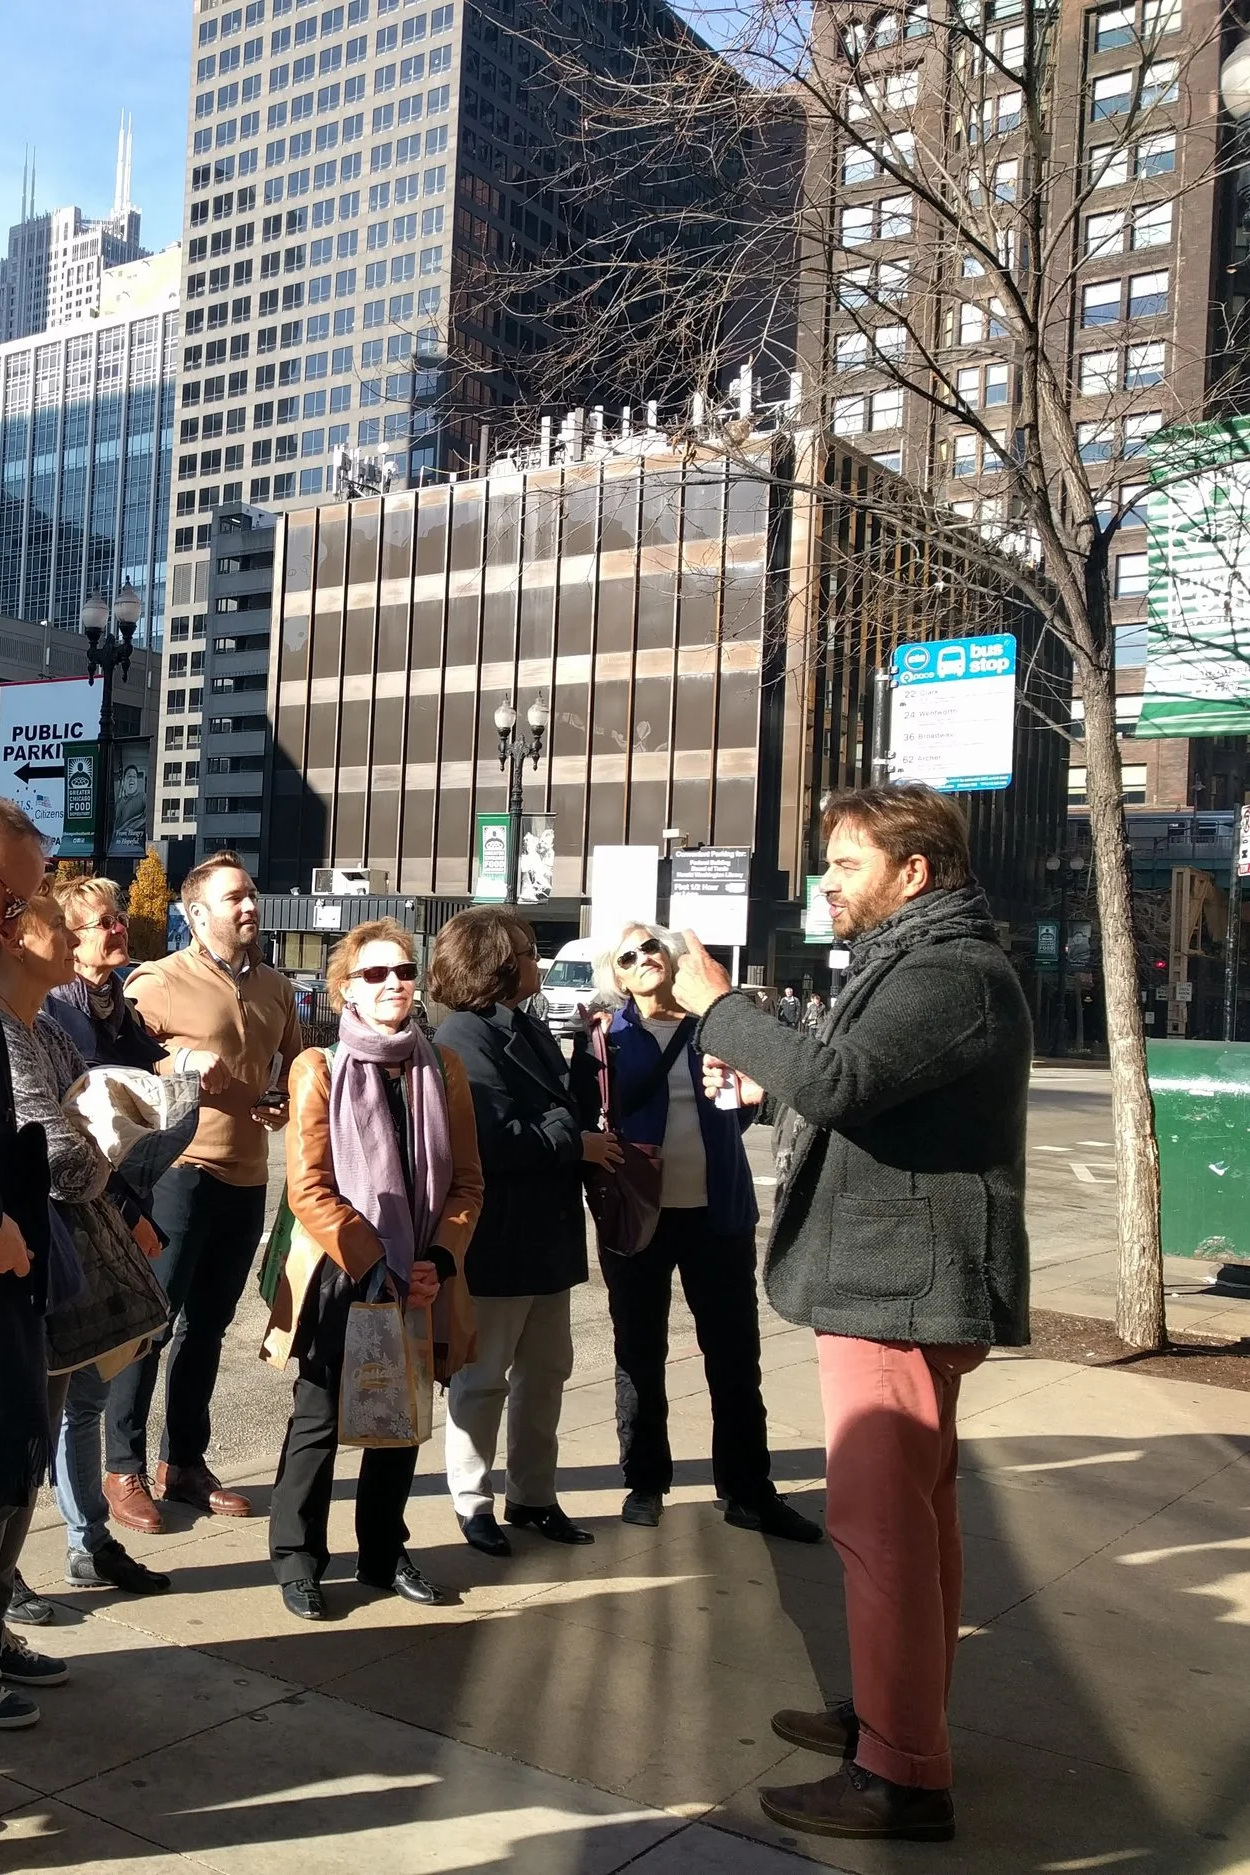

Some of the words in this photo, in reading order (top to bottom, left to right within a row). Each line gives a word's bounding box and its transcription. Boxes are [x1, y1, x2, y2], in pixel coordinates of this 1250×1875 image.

[969, 643, 1004, 659] bus
[969, 657, 1010, 674] stop
[904, 690, 916, 698] 22
[904, 711, 915, 719] 24
[12, 722, 84, 742] PUBLIC
[903, 733, 915, 741] 36
[918, 732, 954, 740] Broadway
[3, 743, 62, 761] PARKI
[902, 755, 914, 764] 62
[918, 754, 941, 762] Archer
[69, 802, 91, 811] FOOD
[35, 809, 64, 820] Citizens
[674, 883, 689, 891] First
[690, 883, 701, 891] 1/2
[702, 883, 720, 891] Hour
